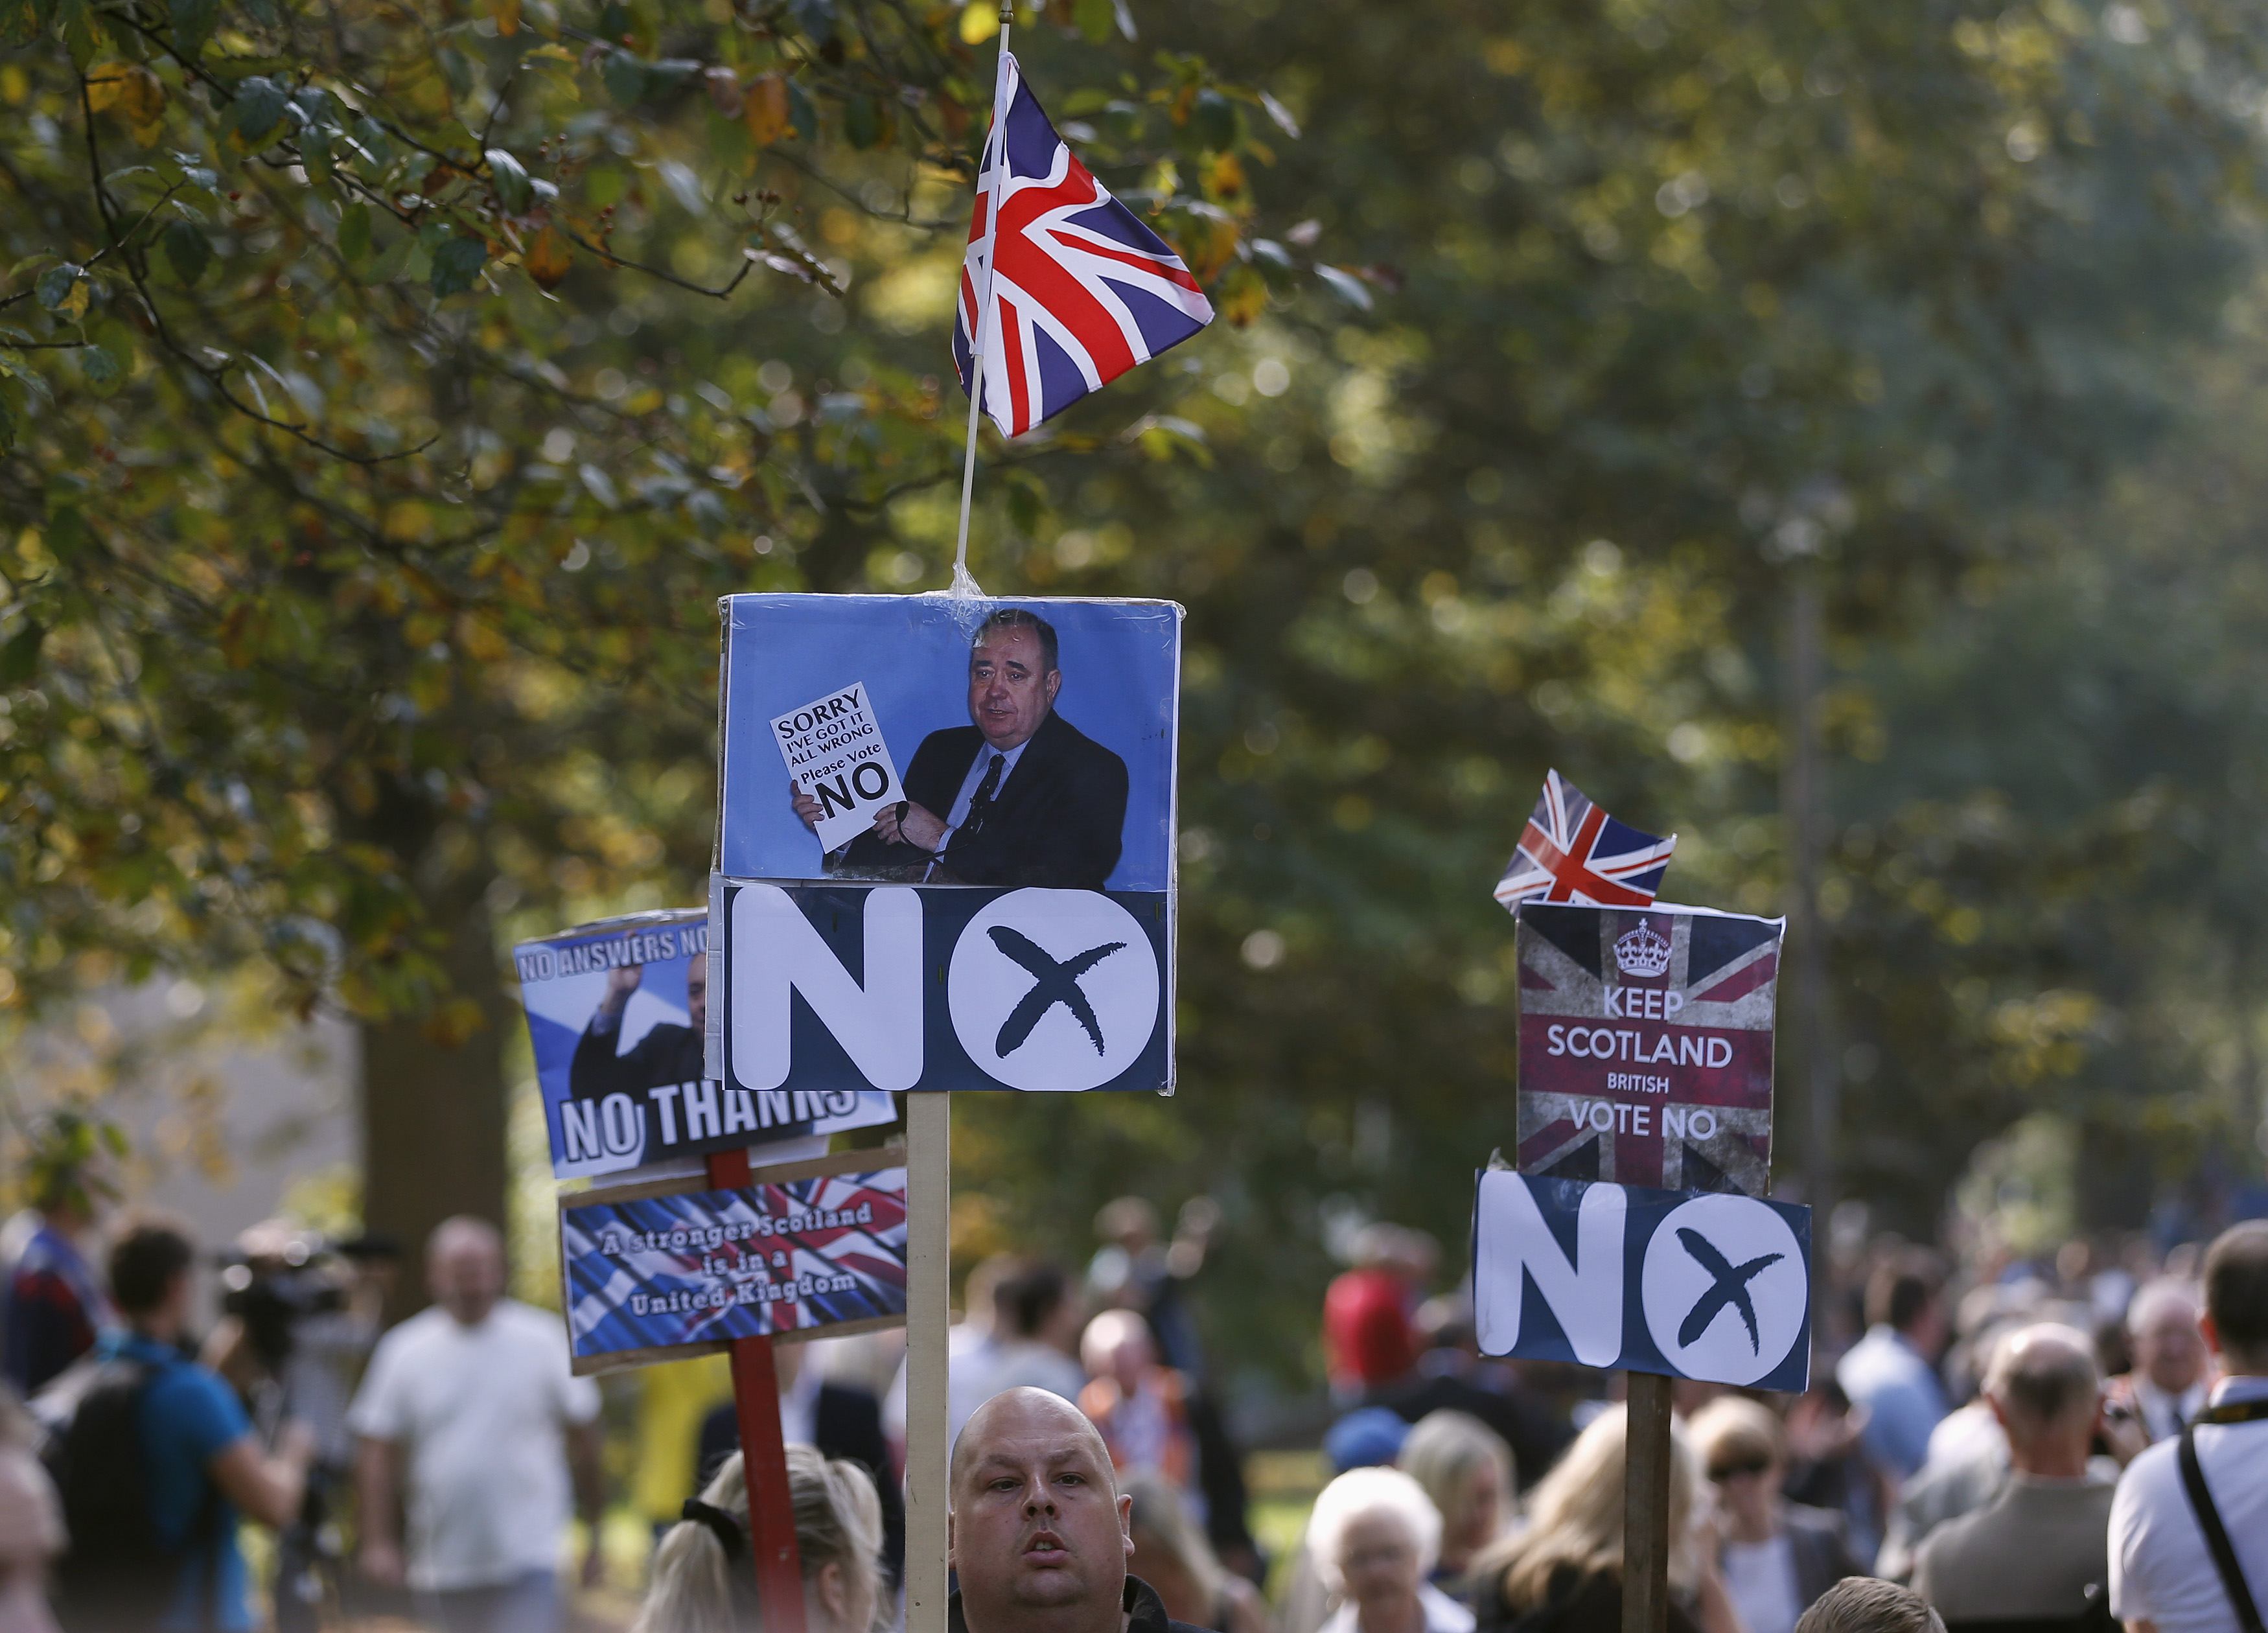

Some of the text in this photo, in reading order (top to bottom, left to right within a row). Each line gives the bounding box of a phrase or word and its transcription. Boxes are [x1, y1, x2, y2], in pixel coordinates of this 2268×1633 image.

[778, 689, 859, 739] SORRY
[787, 711, 863, 754] I'VE GOT IT
[791, 723, 874, 767] ALL WRONG
[801, 743, 881, 784] Please Vote
[815, 761, 889, 819] NO
[519, 949, 556, 984] NO
[557, 931, 678, 978] ANSWERS
[1604, 985, 1684, 1021] KEEP
[1547, 1024, 1733, 1069] SCOTLAND
[1607, 1072, 1670, 1094] BRITISH
[561, 1092, 640, 1163] NO
[1568, 1099, 1717, 1141] VOTE NO
[602, 1201, 873, 1256] A stronger Scotland
[702, 1250, 788, 1277] is in a
[632, 1272, 857, 1317] United Kingdom
